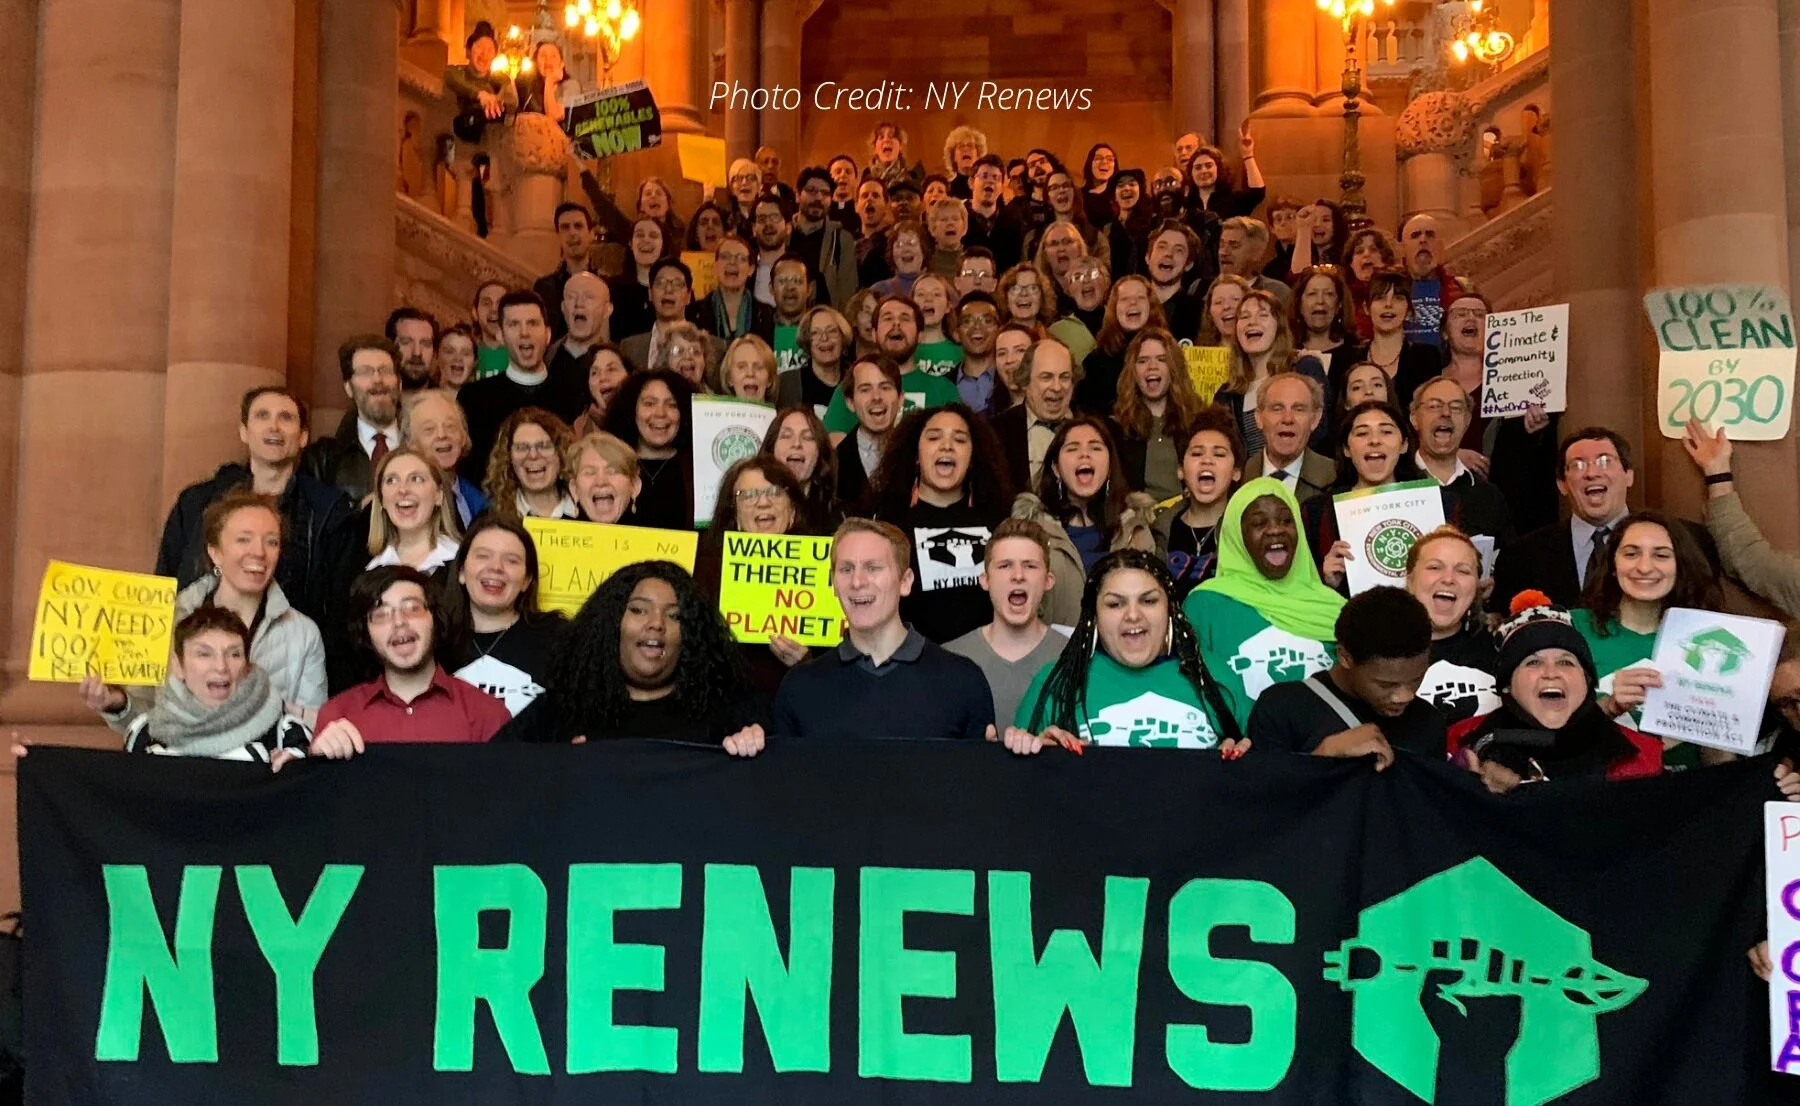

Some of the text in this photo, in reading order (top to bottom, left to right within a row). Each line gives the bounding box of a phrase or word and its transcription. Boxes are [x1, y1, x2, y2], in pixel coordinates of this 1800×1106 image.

[595, 96, 630, 117] 100%
[575, 106, 653, 137] RENEWABLES
[592, 124, 641, 157] NOW
[1664, 289, 1775, 318] 100%
[1487, 311, 1544, 328] Pass The
[1486, 331, 1547, 350] Climate
[1661, 314, 1794, 351] CLEAN
[1485, 351, 1555, 368] Community
[1708, 358, 1741, 375] BY
[1486, 369, 1544, 385] Protection
[1484, 388, 1509, 403] Act
[1667, 375, 1784, 427] 2030
[1350, 499, 1426, 516] NEW YORK CITY
[1382, 520, 1402, 528] YORK
[1402, 521, 1418, 533] CITY
[532, 528, 679, 555] THERE IS NO
[728, 537, 830, 561] WAKE U
[538, 562, 612, 592] PLAN
[729, 562, 817, 587] THERE
[933, 578, 949, 590] NY
[775, 588, 815, 610] NO
[42, 600, 168, 642] NY NEEDS
[726, 611, 835, 637] PLANET
[39, 631, 101, 665] 100%
[96, 862, 1298, 1091] NY RENEWS
